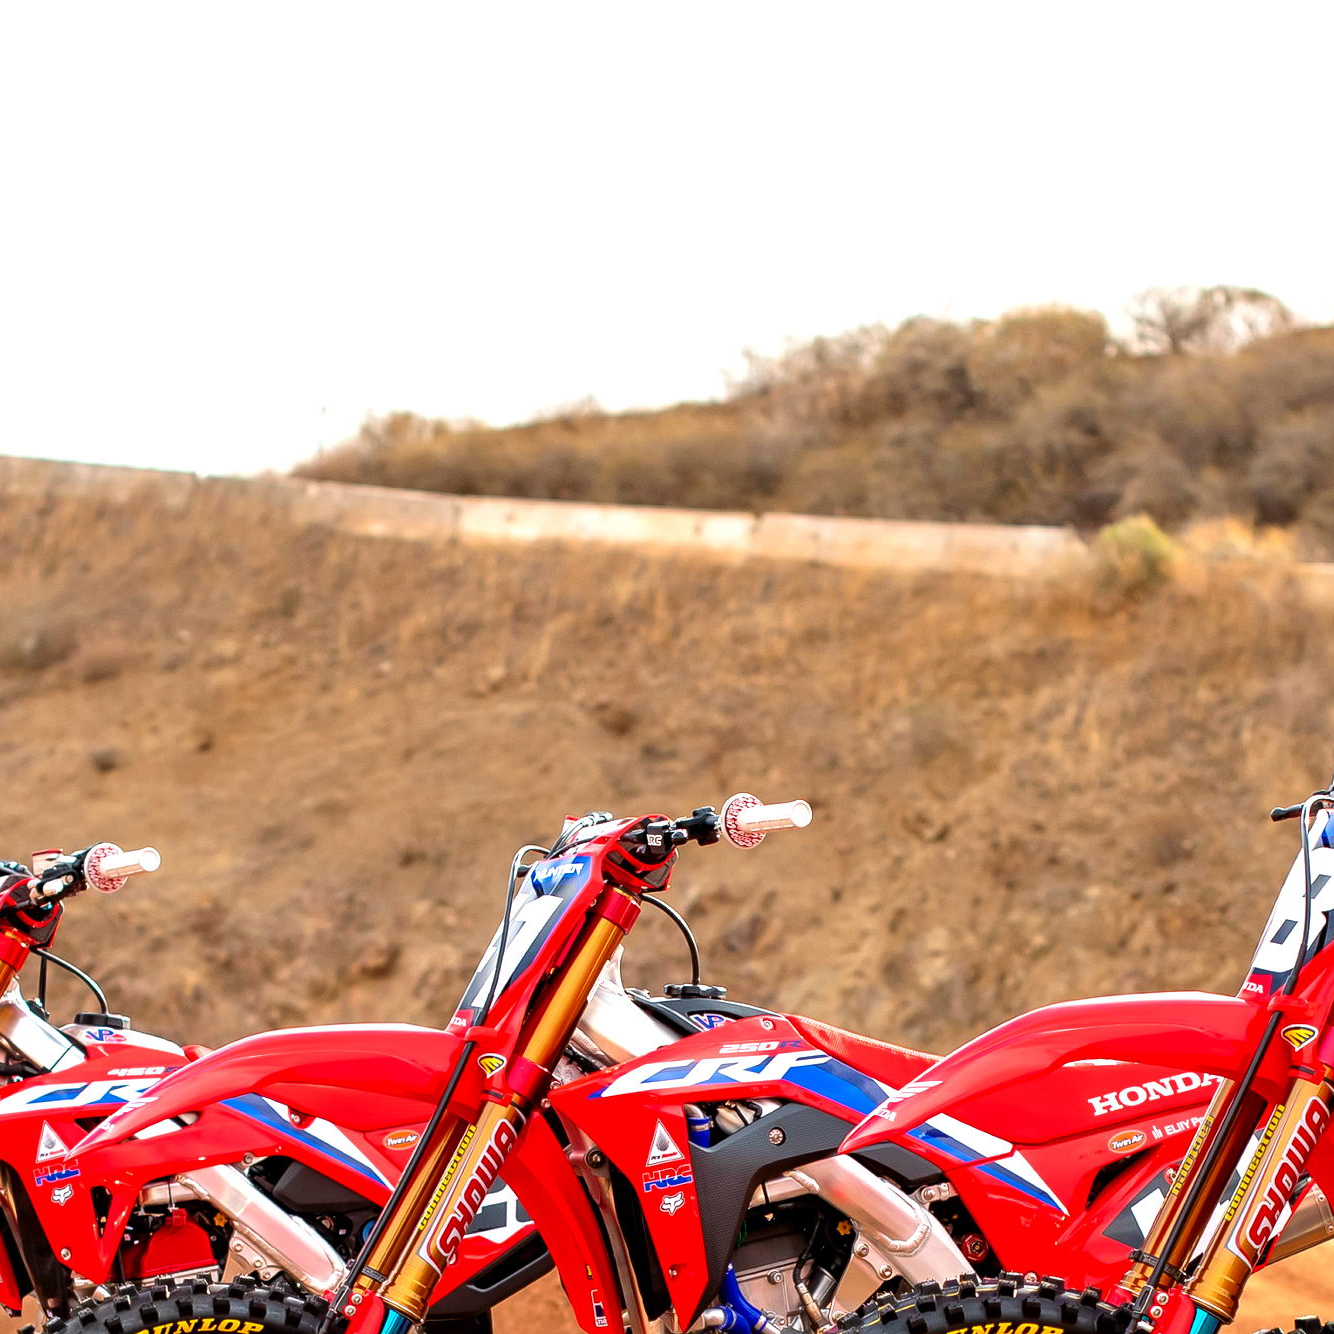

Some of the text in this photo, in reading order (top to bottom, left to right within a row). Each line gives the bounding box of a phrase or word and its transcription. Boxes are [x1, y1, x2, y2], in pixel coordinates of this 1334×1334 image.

[719, 1040, 805, 1054] 250R
[600, 1049, 833, 1098] CRF
[1087, 1071, 1225, 1117] HONDA
[1111, 1133, 1145, 1151] Twin Air
[33, 1159, 81, 1186] HRC
[435, 1118, 519, 1260] SHOWA
[642, 1164, 693, 1192] HRC
[1246, 1096, 1333, 1250] SHOWA
